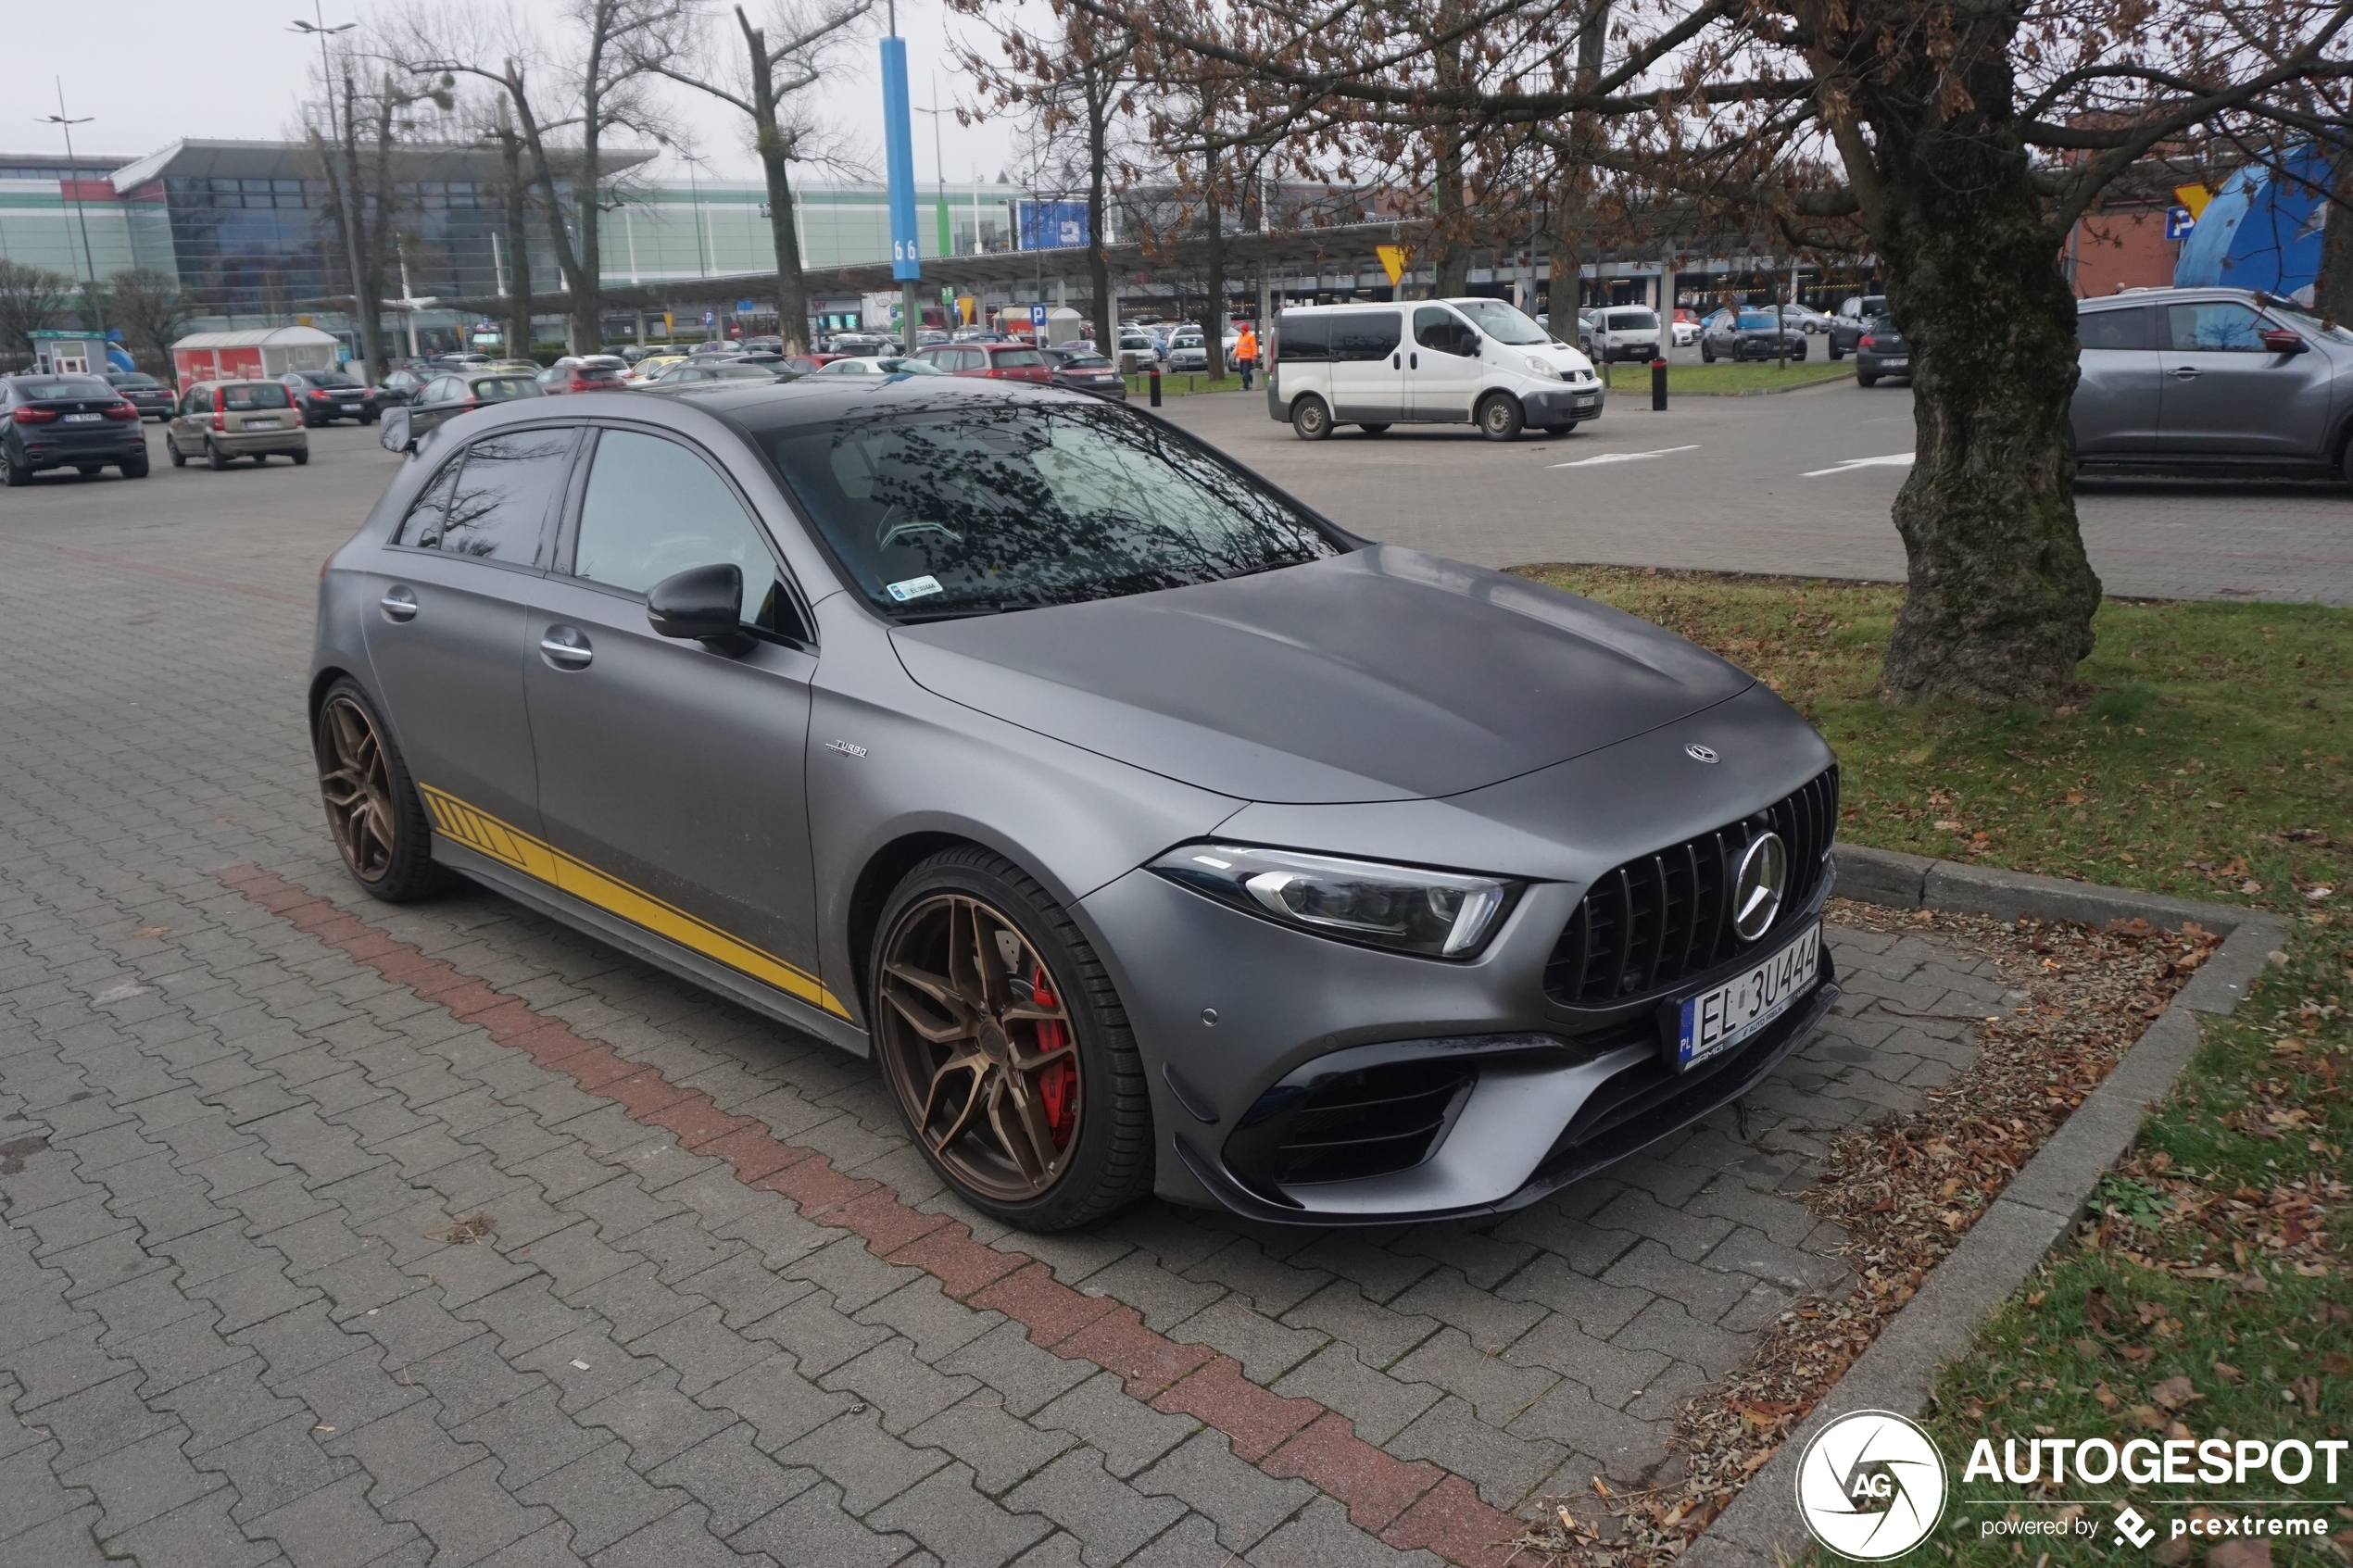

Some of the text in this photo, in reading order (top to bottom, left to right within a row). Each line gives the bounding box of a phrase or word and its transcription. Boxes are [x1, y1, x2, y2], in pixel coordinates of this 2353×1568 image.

[2173, 209, 2196, 236] P
[705, 312, 712, 321] P
[1033, 307, 1044, 323] P
[837, 739, 867, 756] TURBO
[1700, 928, 1817, 1047] EL 3U444
[1749, 1018, 1766, 1034] AUTO
[1680, 1038, 1692, 1053] PL
[1697, 1044, 1724, 1063] AMG
